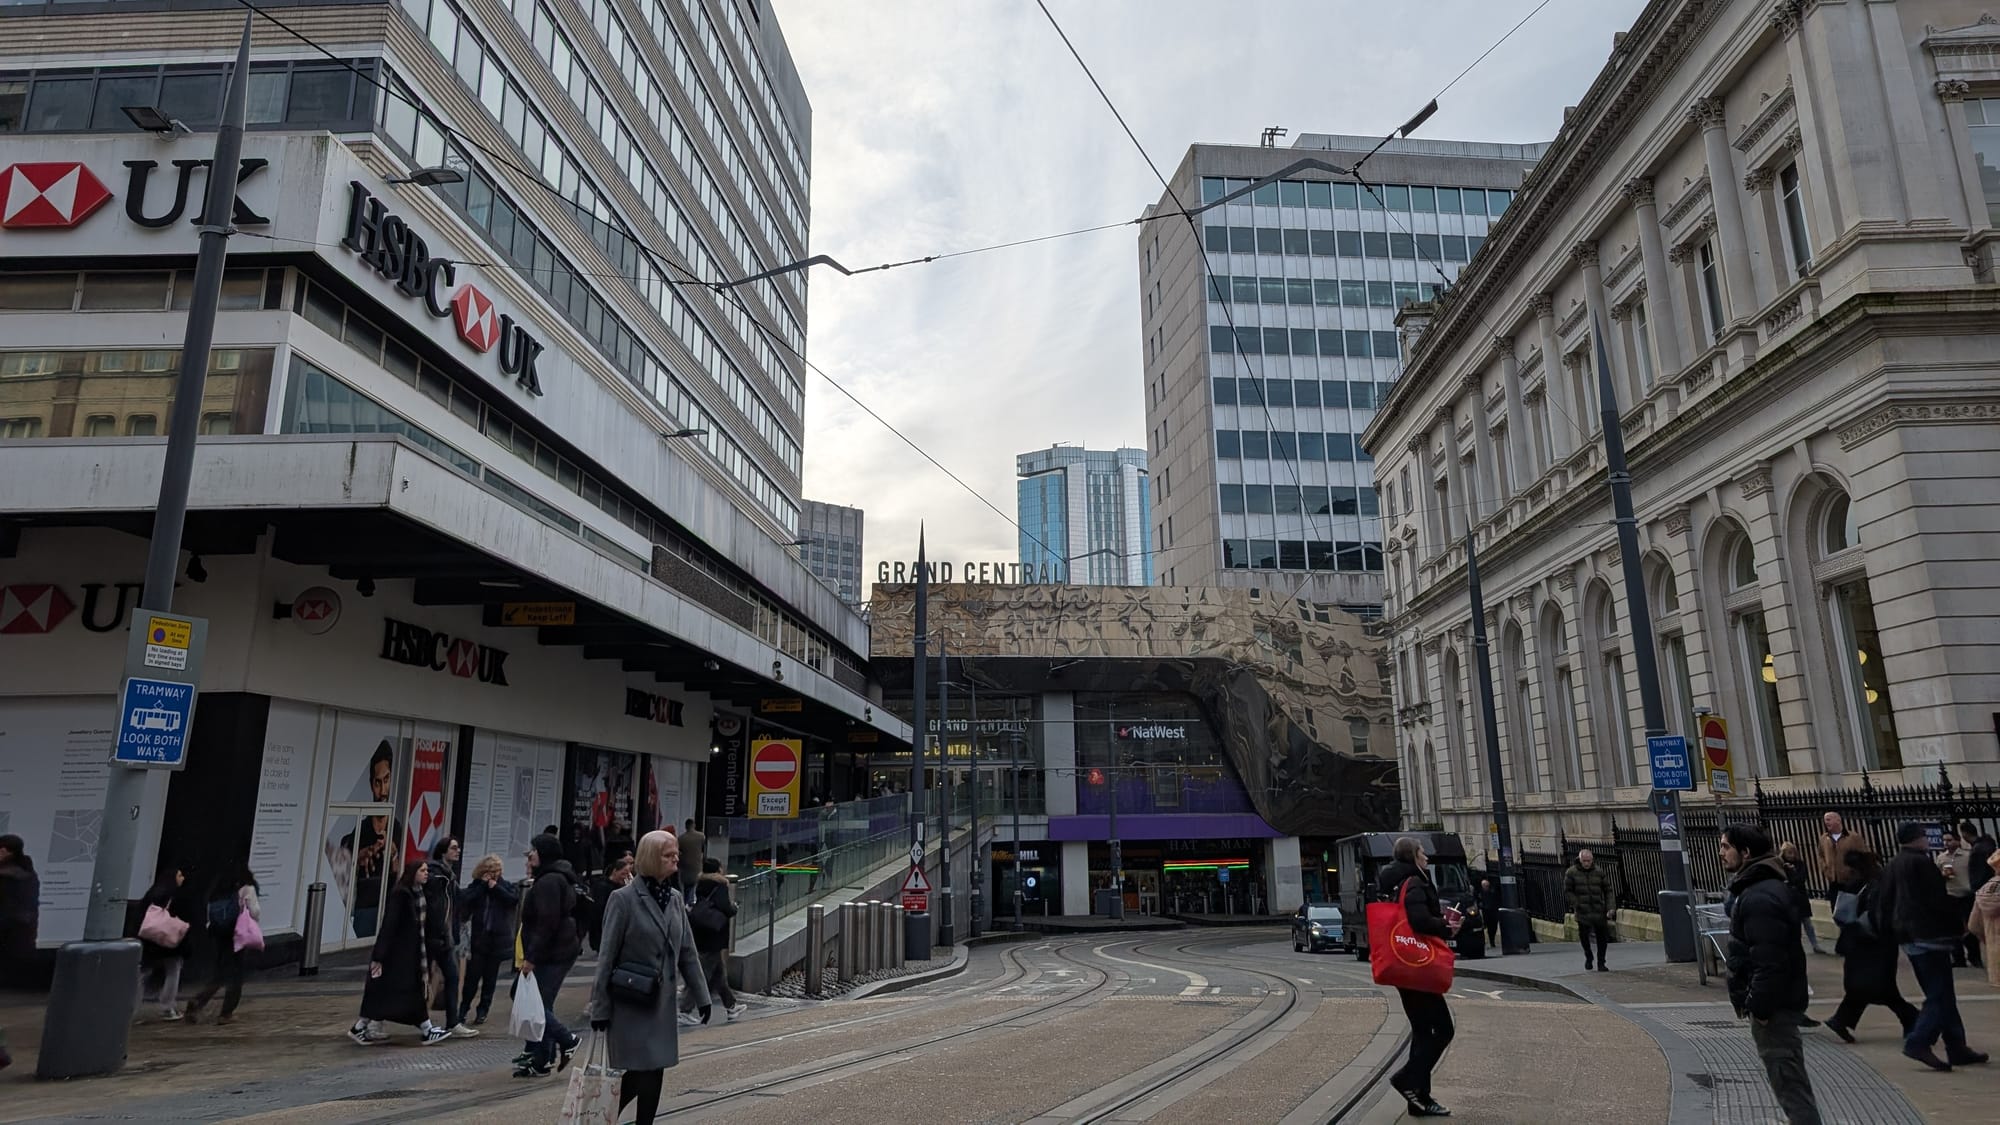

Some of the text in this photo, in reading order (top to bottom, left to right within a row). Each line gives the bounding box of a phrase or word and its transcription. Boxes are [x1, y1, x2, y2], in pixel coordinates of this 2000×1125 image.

[123, 158, 270, 228] UK
[342, 181, 545, 397] HSBC UK
[878, 561, 1064, 584] GRAND CENTRAL
[523, 605, 572, 613] Pedestrians
[527, 614, 568, 622] Keep Left
[380, 618, 509, 686] HSBC UK
[135, 683, 187, 700] TRAMWAY
[975, 719, 1024, 731] ENTRAL
[1132, 725, 1185, 738] NatWest
[123, 732, 181, 746] LOOK BOTH
[1651, 739, 1681, 747] TRAMWAY
[136, 746, 165, 758] WAYS
[724, 739, 741, 815] Premier Inn
[1671, 770, 1688, 778] BOTH
[1663, 778, 1681, 786] WAYS
[761, 796, 787, 805] Except
[762, 804, 785, 812] Trams
[912, 849, 922, 857] 10
[1019, 850, 1040, 860] HILL
